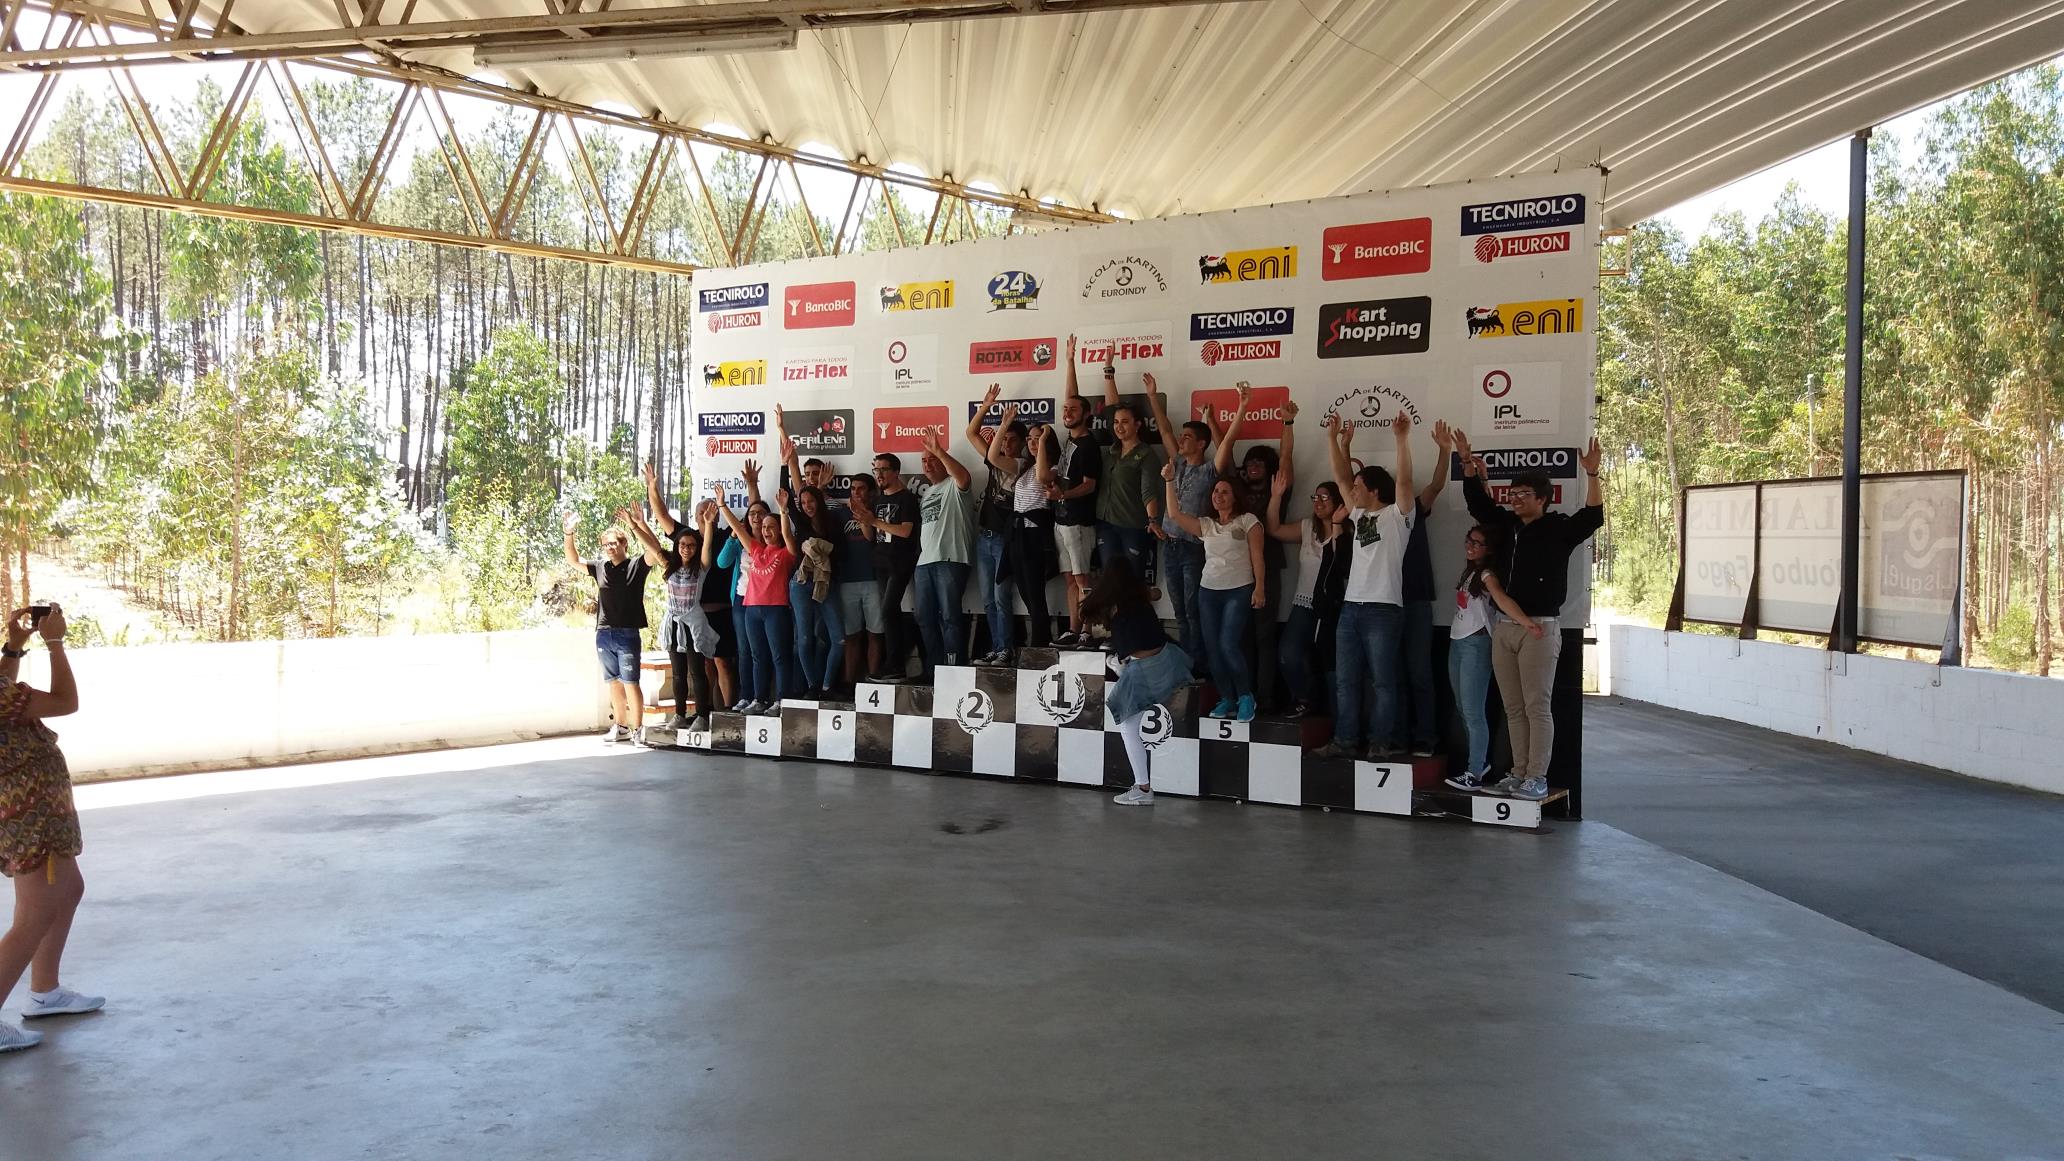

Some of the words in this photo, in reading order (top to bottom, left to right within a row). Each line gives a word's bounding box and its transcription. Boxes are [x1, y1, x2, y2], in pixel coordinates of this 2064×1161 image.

[1470, 198, 1576, 222] TECNIROLO
[1354, 240, 1424, 259] BancoBIC
[1508, 236, 1564, 254] HURON
[1238, 246, 1290, 281] eni
[994, 272, 1026, 294] 24
[1082, 259, 1117, 298] ESCOLA
[1126, 256, 1168, 292] KARTING
[704, 285, 764, 303] TECNIROLO
[910, 280, 950, 310] eni
[1101, 286, 1147, 298] EUROINDY
[805, 299, 851, 313] BancoBIC
[1346, 306, 1387, 323] Kart
[726, 314, 758, 327] HURON
[1198, 310, 1287, 330] TECNIROLO
[1512, 298, 1575, 336] eni
[1324, 318, 1421, 347] Shopping
[976, 350, 1022, 364] ROTAX
[1228, 344, 1276, 358] HURON
[728, 360, 762, 387] eni
[784, 364, 848, 380] Izzi-Flex
[896, 368, 912, 380] IPL
[1220, 408, 1282, 422] BacoBIC
[1320, 388, 1362, 428] ESCOLA
[1373, 386, 1422, 426] KARTING
[1494, 405, 1522, 418] IPL
[702, 414, 760, 427] TECNIROLO
[722, 441, 754, 452] HURON
[1471, 450, 1568, 468] CNIROLO
[868, 689, 880, 708] 4
[1050, 671, 1072, 708] 1
[966, 692, 985, 718] 2
[832, 714, 842, 730] 6
[1142, 706, 1162, 734] 3
[686, 732, 702, 746] 10
[758, 728, 768, 744] 8
[1218, 721, 1232, 739] 5
[1376, 768, 1391, 788] 7
[1496, 802, 1511, 821] 9
